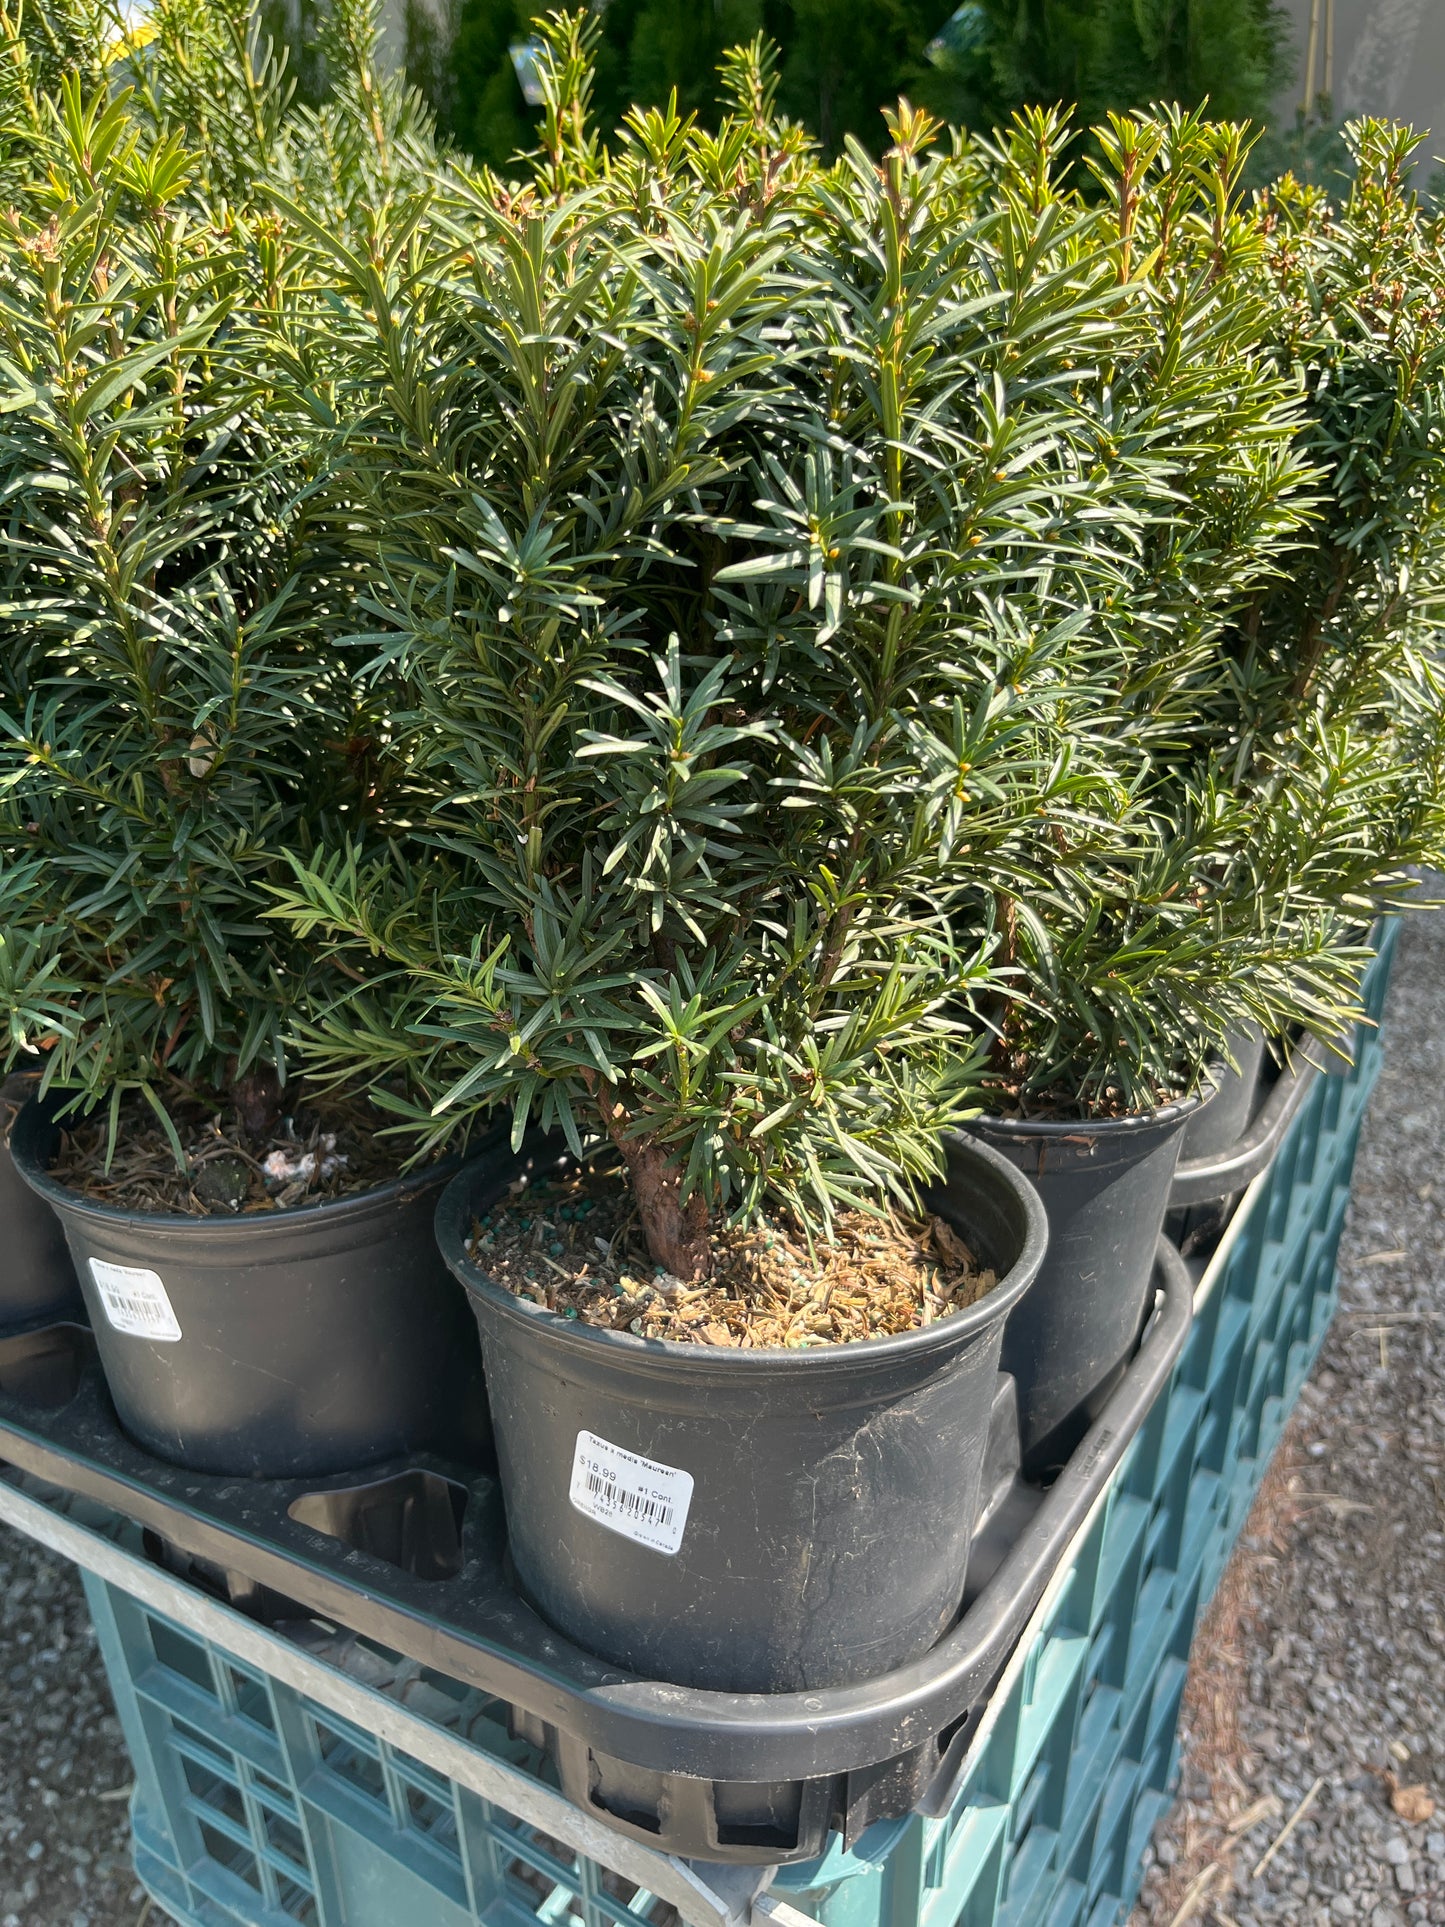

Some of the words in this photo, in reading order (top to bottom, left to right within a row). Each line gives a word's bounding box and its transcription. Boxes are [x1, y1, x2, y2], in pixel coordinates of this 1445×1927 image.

[588, 1435, 608, 1451] Taxus
[616, 1451, 638, 1464] media
[579, 1455, 617, 1482] $18.99
[651, 1490, 673, 1504] Cont.
